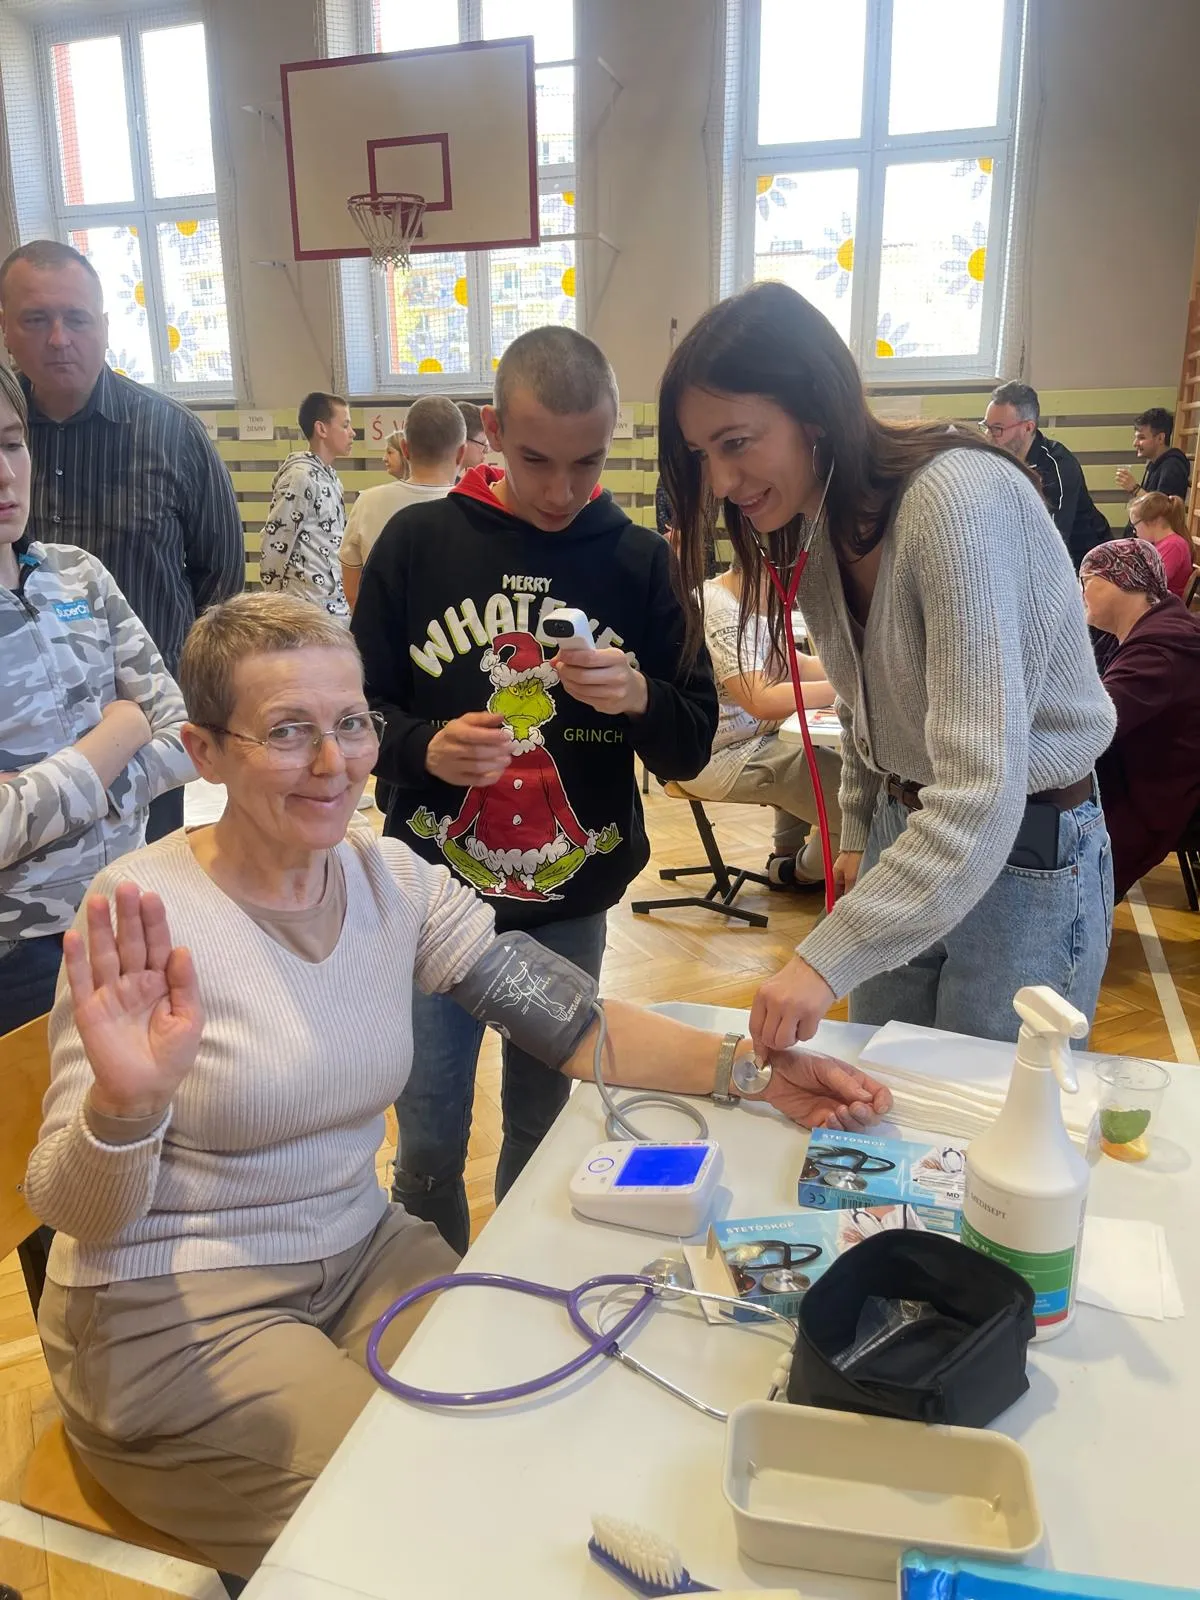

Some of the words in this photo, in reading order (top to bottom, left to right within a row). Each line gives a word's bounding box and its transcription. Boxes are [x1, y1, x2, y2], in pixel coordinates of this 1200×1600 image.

[502, 574, 552, 593] MERRY
[563, 727, 624, 744] GRINCH
[821, 1133, 887, 1148] STETOSKOP
[946, 1191, 960, 1199] MD
[726, 1221, 795, 1234] STETOSKOP
